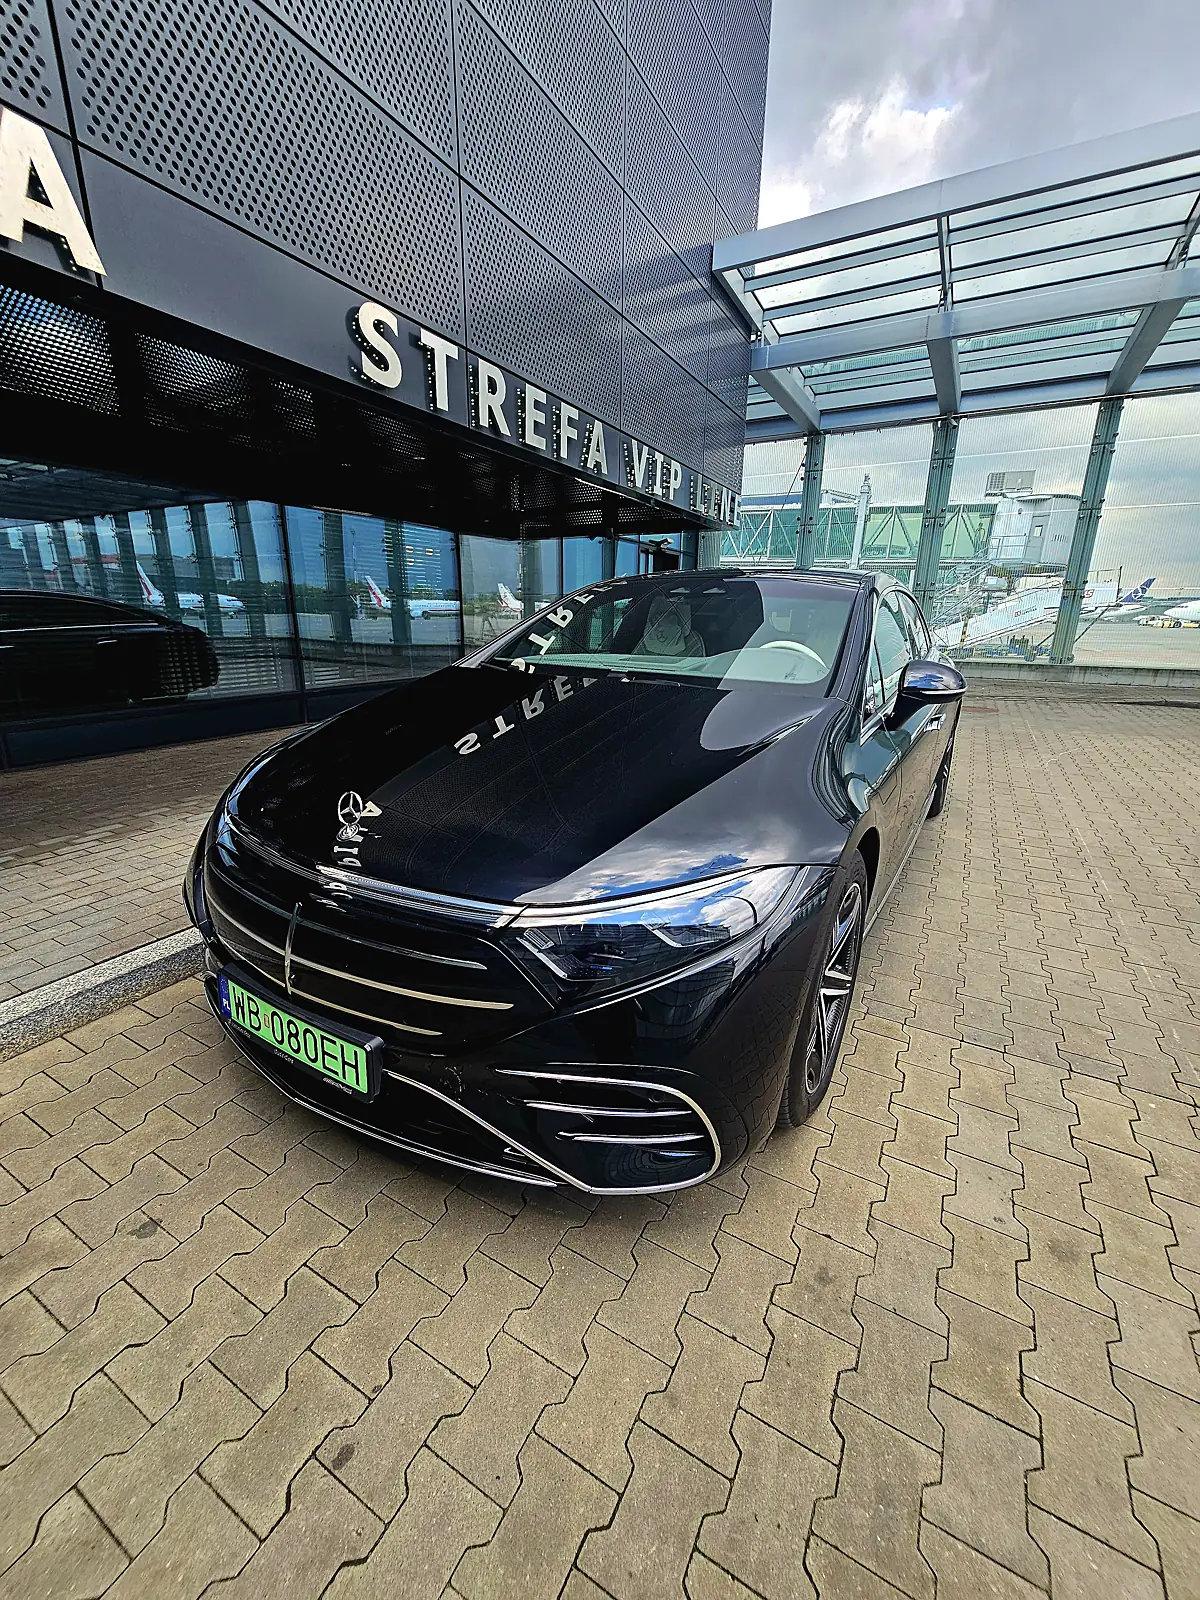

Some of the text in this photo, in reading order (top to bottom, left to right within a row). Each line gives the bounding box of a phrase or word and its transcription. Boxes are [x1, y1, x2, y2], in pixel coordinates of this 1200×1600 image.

[0, 106, 107, 277] A
[355, 300, 740, 527] STREFA VIP LINE
[222, 998, 231, 1011] PL
[231, 985, 361, 1087] WB 080EH
